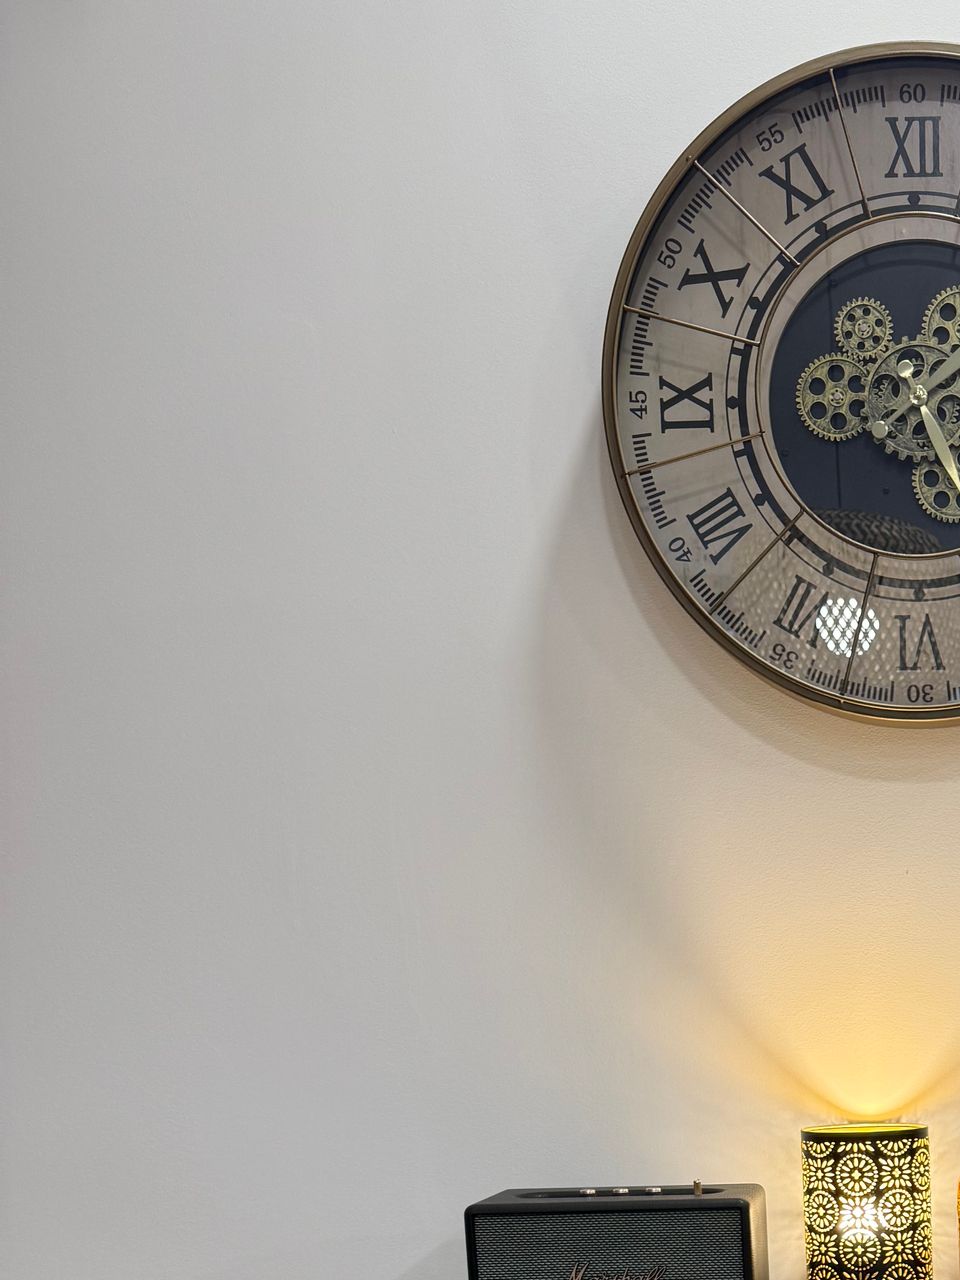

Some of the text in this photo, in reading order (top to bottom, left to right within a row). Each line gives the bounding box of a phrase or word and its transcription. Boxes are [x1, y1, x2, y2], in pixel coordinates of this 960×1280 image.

[899, 84, 926, 103] 60
[756, 122, 786, 152] 55
[884, 116, 943, 178] XII
[759, 143, 835, 225] XI
[657, 237, 683, 269] 50
[677, 238, 750, 318] X
[630, 390, 649, 420] 45
[659, 371, 715, 434] IX
[687, 487, 754, 566] VIII
[667, 536, 693, 563] 40
[772, 575, 829, 648] VII
[769, 643, 799, 671] 35
[895, 614, 946, 671] VI
[906, 683, 934, 703] 30
